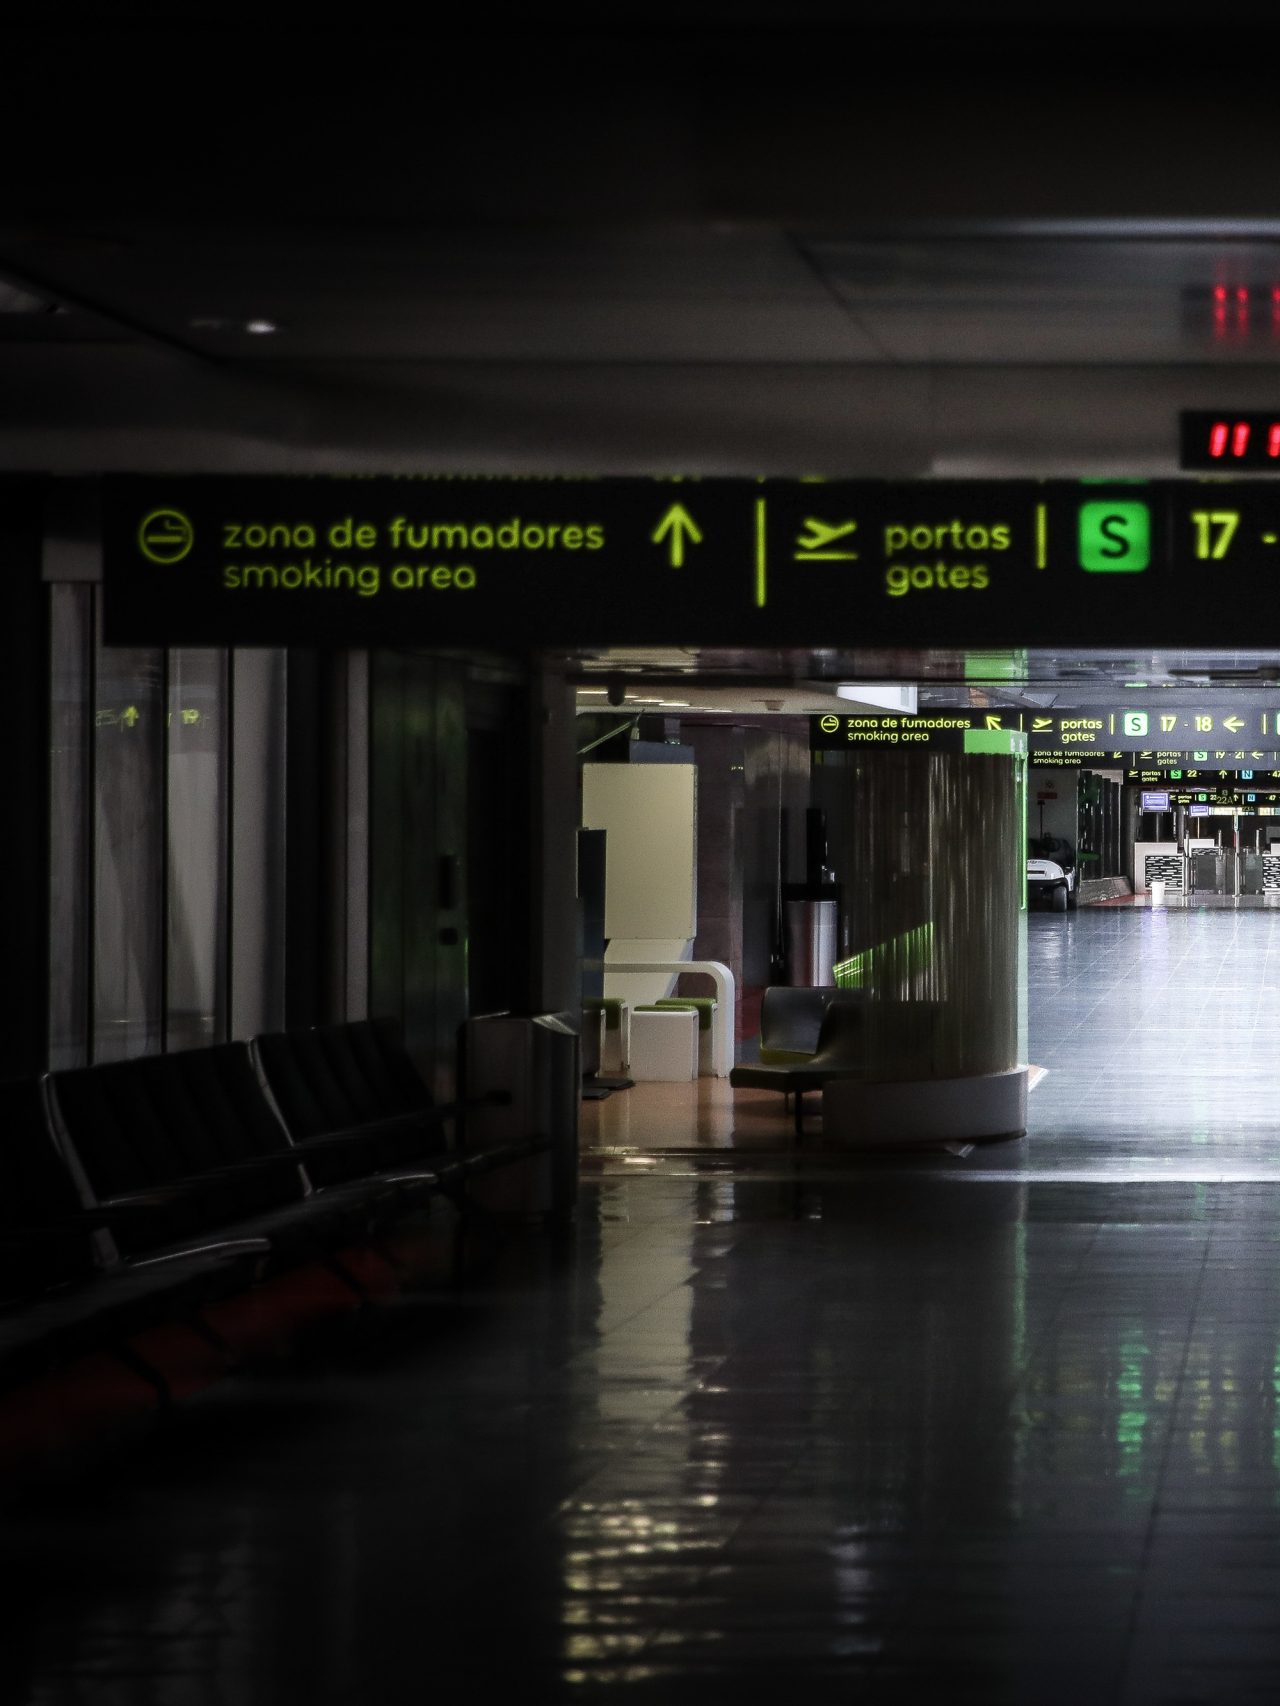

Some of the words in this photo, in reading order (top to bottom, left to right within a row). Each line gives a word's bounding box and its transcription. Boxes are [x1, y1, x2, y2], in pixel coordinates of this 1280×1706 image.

[222, 523, 316, 550] zona
[328, 518, 377, 550] de
[389, 517, 605, 551] fumadores
[884, 519, 1011, 555] portas
[1098, 514, 1132, 559] S
[1192, 511, 1240, 559] 17
[222, 559, 380, 597] smoking
[390, 565, 477, 590] area
[885, 562, 990, 598] gates
[847, 719, 879, 729] zona
[881, 717, 898, 729] de
[900, 717, 971, 729] fumadores
[1060, 717, 1103, 731] portas
[1160, 715, 1178, 732] 17
[1194, 715, 1213, 733] 18
[847, 730, 898, 743] smoking
[901, 732, 930, 742] area
[1061, 731, 1096, 745] gates
[1033, 757, 1064, 765] smoking
[1157, 752, 1181, 760] portas
[1141, 770, 1161, 778] portas
